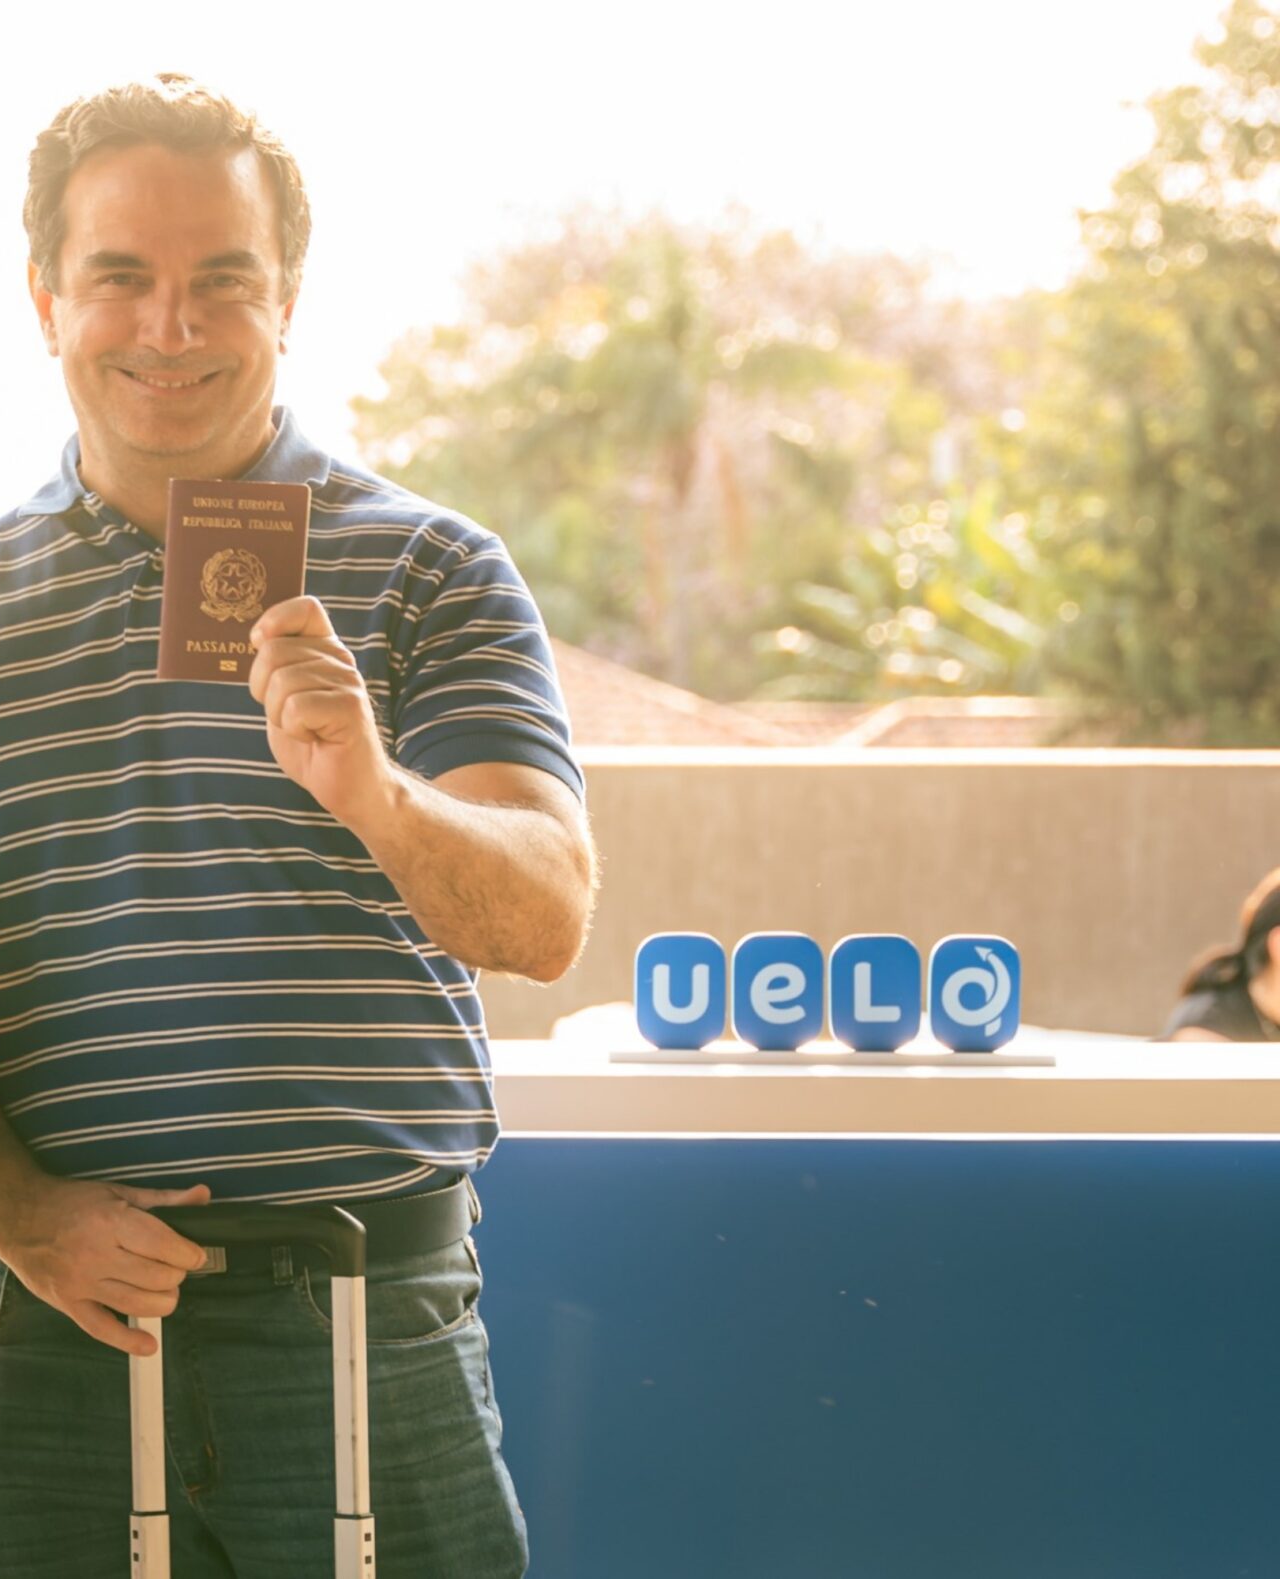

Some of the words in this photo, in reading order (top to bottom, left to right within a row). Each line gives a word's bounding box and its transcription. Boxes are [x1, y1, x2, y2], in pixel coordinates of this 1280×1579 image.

[192, 497, 234, 510] UNIONE
[237, 499, 286, 512] EUROPEA
[248, 519, 295, 532] ITALIANA
